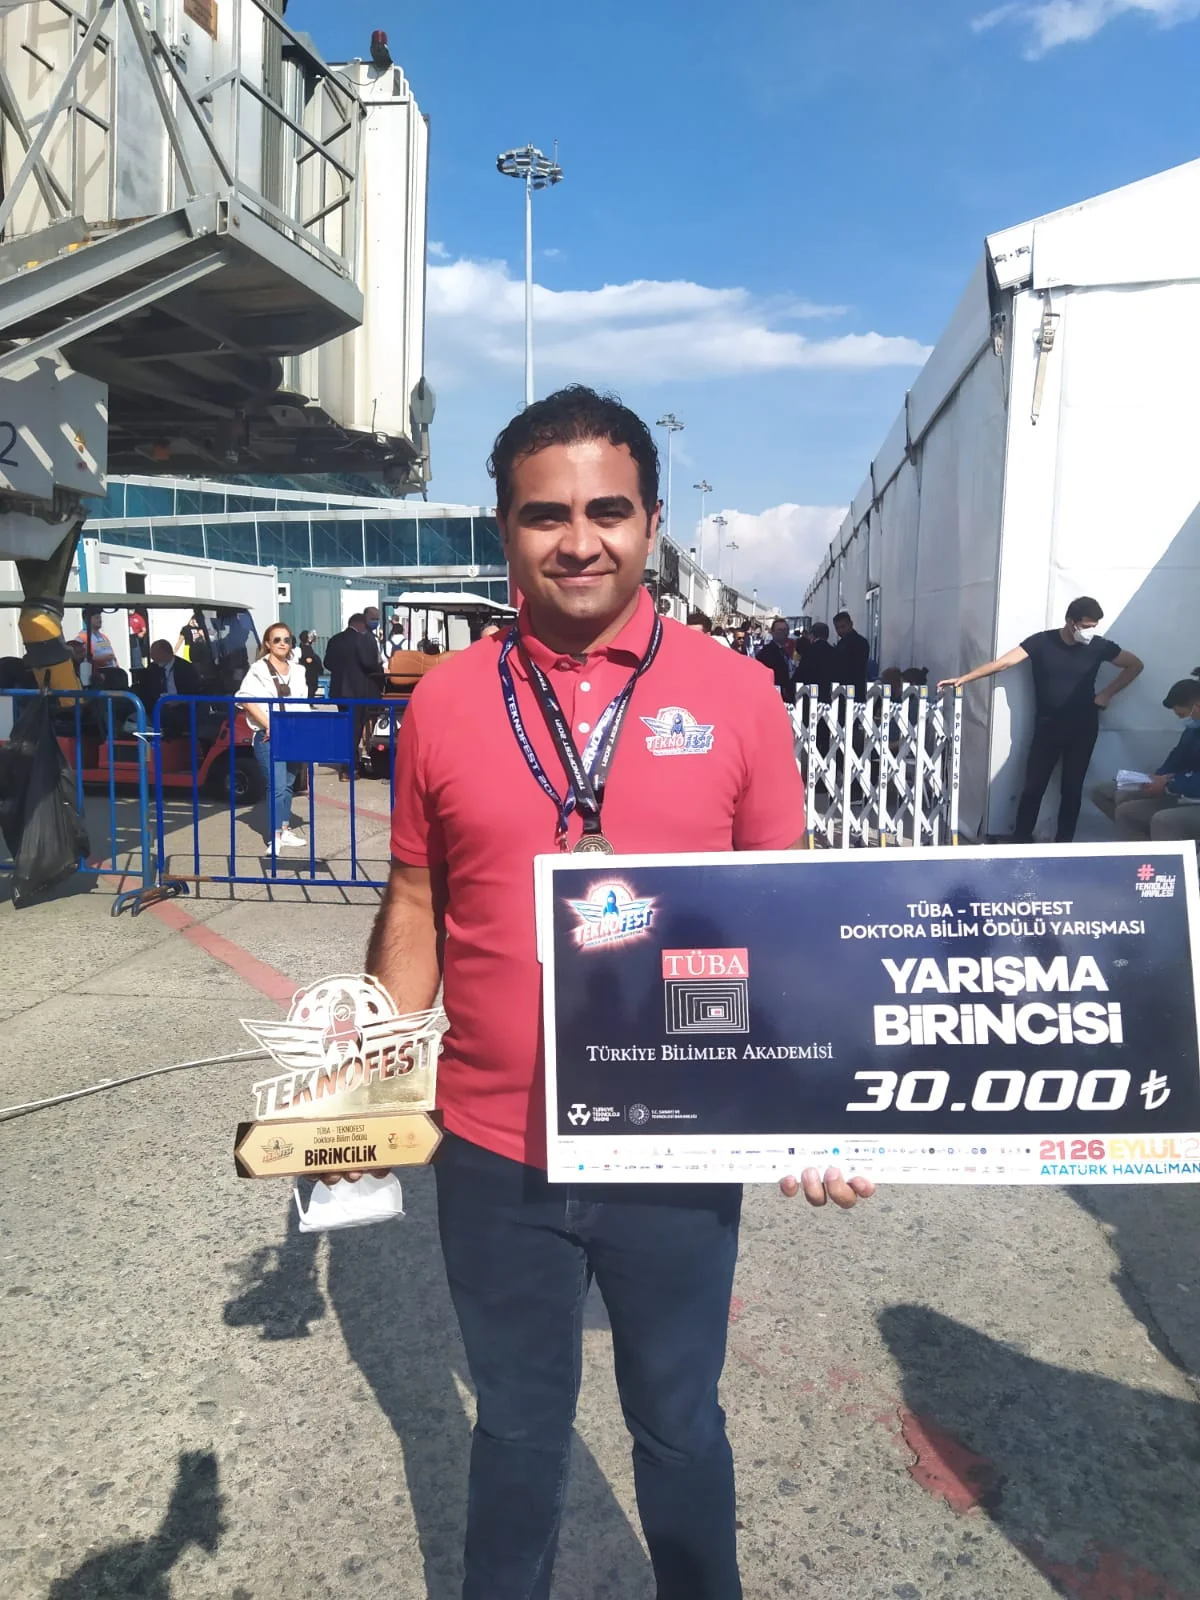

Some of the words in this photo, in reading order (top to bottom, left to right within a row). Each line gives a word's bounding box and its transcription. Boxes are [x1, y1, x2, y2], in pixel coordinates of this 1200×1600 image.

[507, 694, 541, 772] TEKNOFEST
[554, 718, 567, 740] 2021
[582, 701, 617, 775] EKNOFEST
[646, 733, 713, 750] TEKNOFEST
[562, 740, 586, 790] TEKNOFEST
[601, 745, 612, 767] 2021
[907, 900, 954, 917] TÜBA
[969, 901, 1073, 916] TEKNOFEST
[574, 909, 654, 945] TEKNOFEST
[840, 924, 926, 939] DOKTORA
[930, 919, 979, 938] BİLİM
[982, 917, 1046, 937] ÖDÜLÜ
[1051, 919, 1145, 939] YARIŞMASI
[664, 949, 746, 976] TÜBA
[881, 955, 1109, 996] YARIŞMA
[873, 1002, 1124, 1046] BİRİNCİSİ
[585, 1044, 656, 1062] TÜRKİYE
[660, 1043, 738, 1061] BİLİMLER
[742, 1042, 834, 1060] AKADEMİSİ
[254, 1033, 437, 1119] TEKNOFEST
[845, 1069, 1131, 1112] 30.000
[336, 1125, 365, 1133] TEKNOFEST
[304, 1145, 377, 1167] BİRİNCİLİK
[1040, 1139, 1065, 1160] 21
[1070, 1139, 1106, 1160] 26
[1040, 1164, 1108, 1176] ATATÜRK
